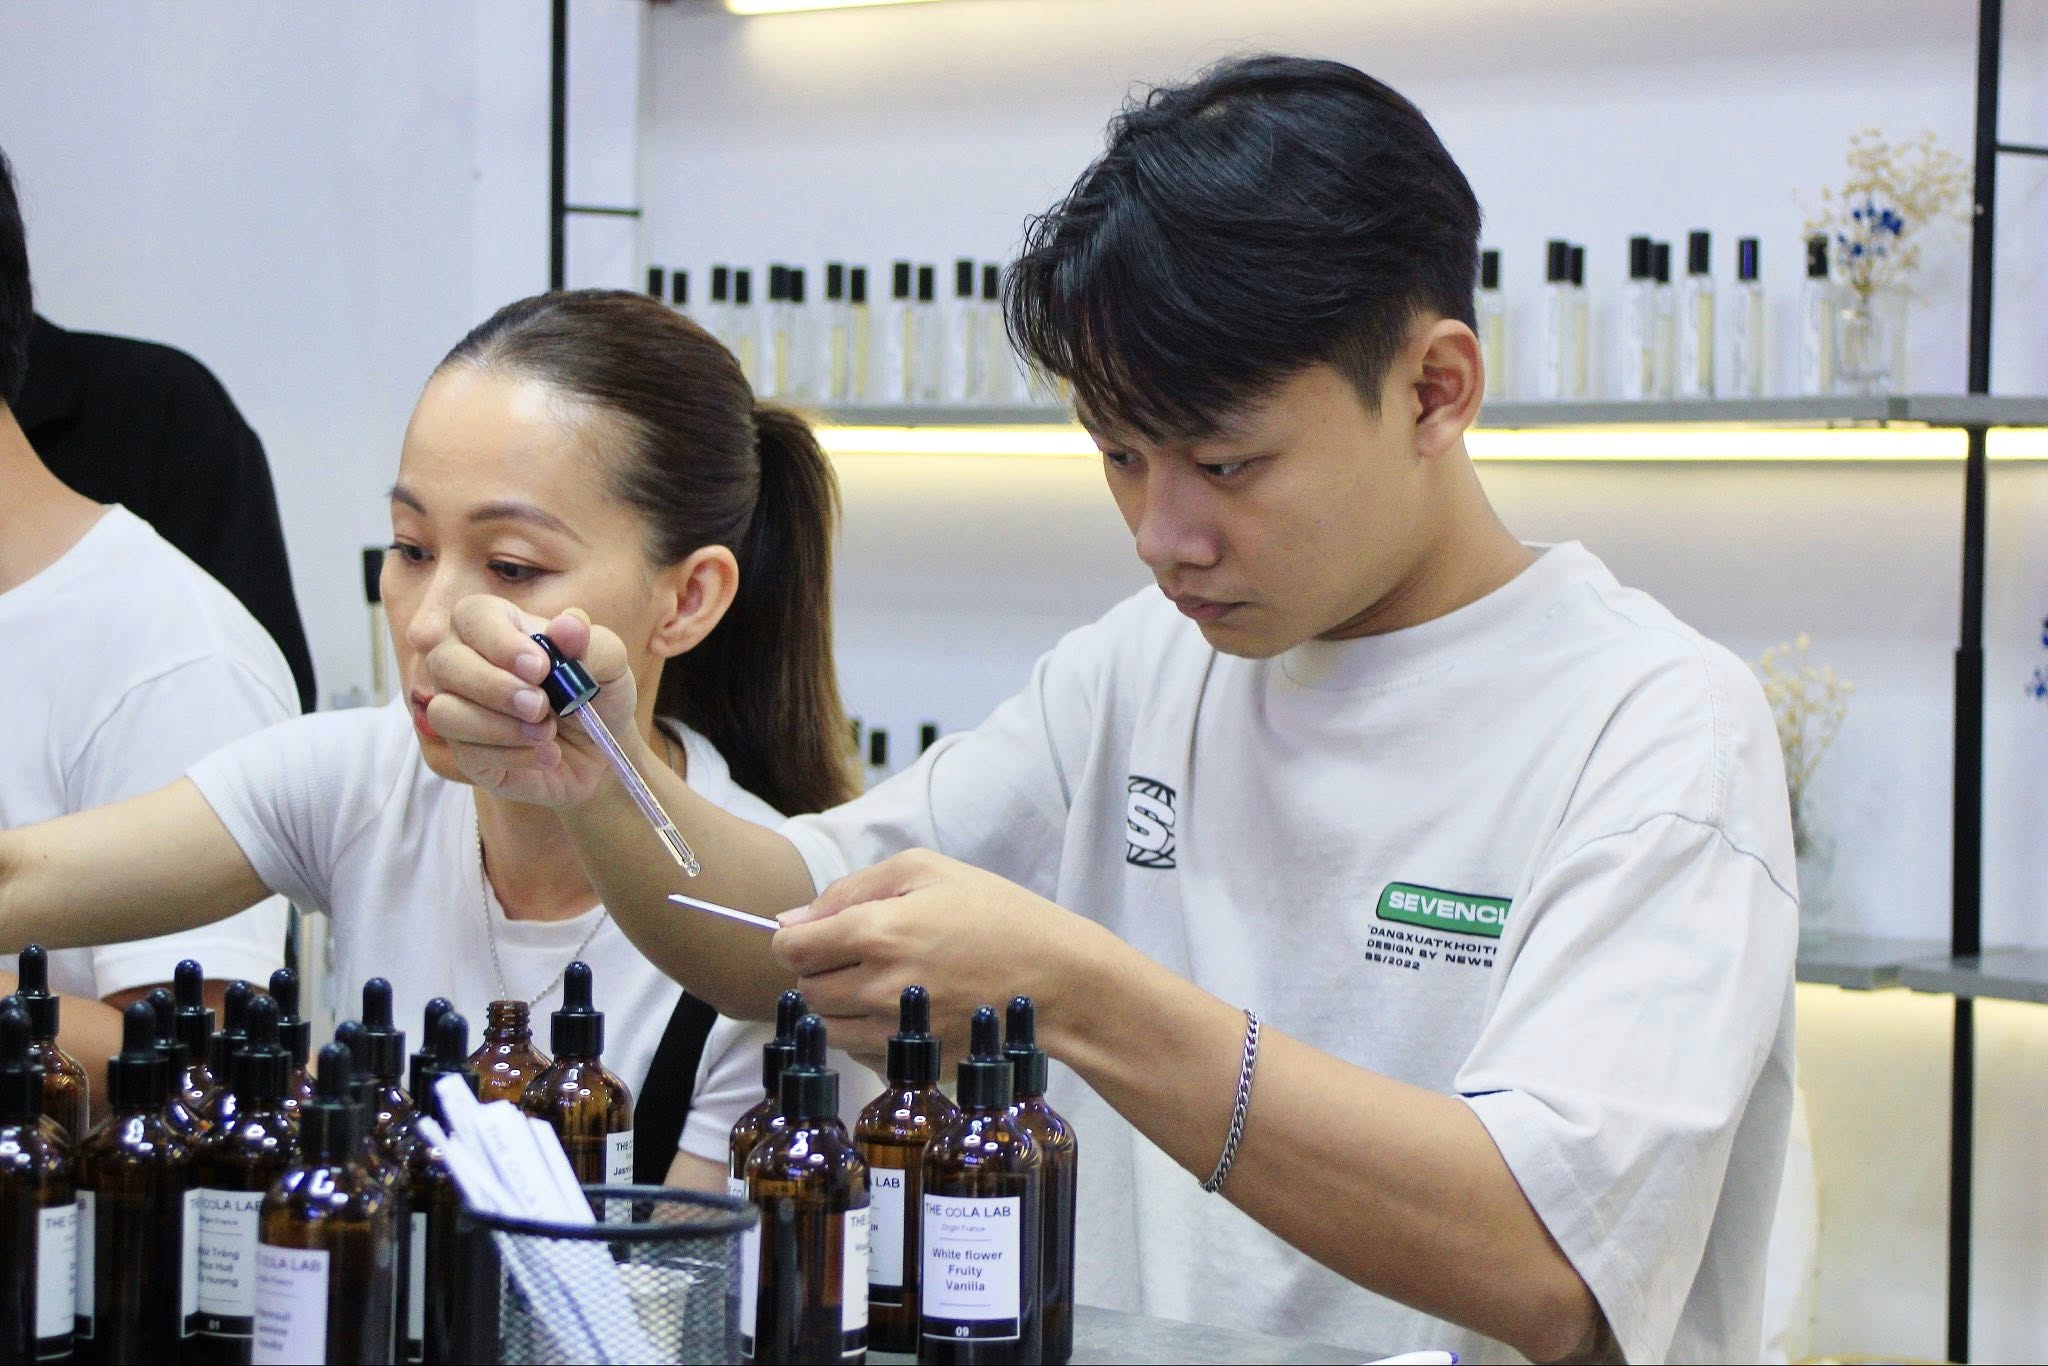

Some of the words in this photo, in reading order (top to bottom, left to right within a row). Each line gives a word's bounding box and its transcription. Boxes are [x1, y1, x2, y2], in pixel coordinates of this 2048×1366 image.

[1367, 939, 1414, 956] DESIGN
[1419, 949, 1437, 960] BY
[876, 1176, 900, 1188] LAB
[926, 1203, 941, 1216] THE
[984, 1206, 1011, 1217] LAB
[932, 1248, 961, 1260] White
[965, 1249, 1003, 1260] flower
[948, 1264, 982, 1278] Fruity
[946, 1280, 985, 1291] Vanilla
[955, 1326, 969, 1337] 09
